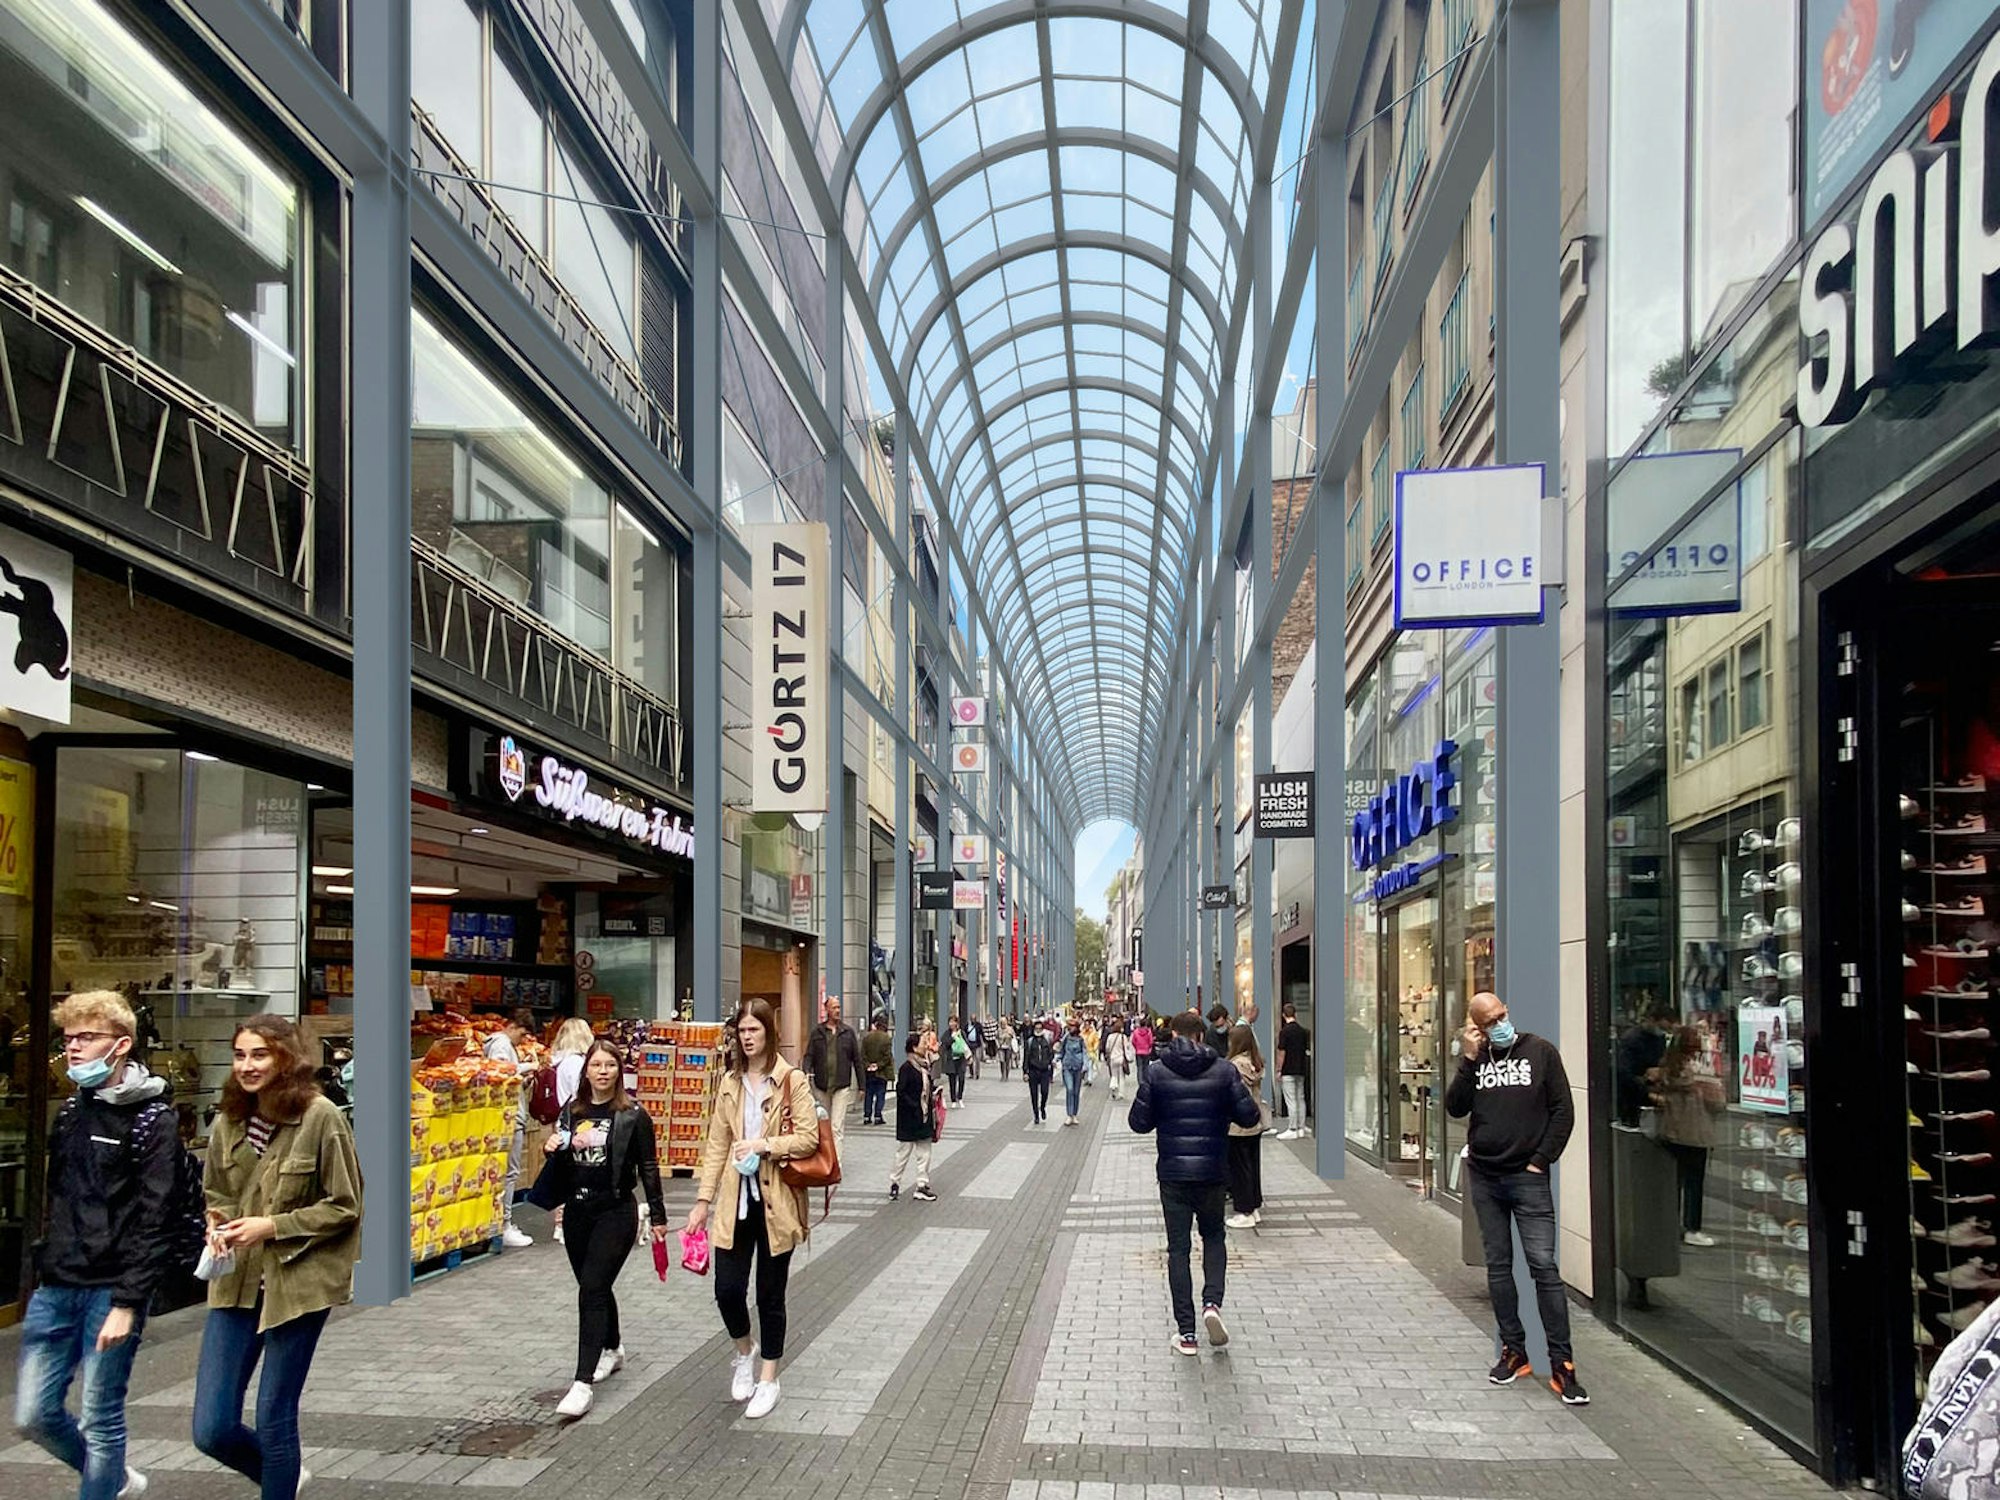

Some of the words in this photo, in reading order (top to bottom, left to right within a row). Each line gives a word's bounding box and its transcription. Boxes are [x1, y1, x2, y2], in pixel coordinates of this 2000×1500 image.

[772, 542, 806, 586] 17
[1413, 557, 1532, 582] OFFICE
[1449, 581, 1494, 591] LONDON
[767, 610, 806, 793] GÖRTZ
[535, 756, 649, 839] Süßwaren
[1260, 781, 1307, 797] LUSH
[1260, 797, 1307, 811] FRESH
[1352, 740, 1459, 871] OFFICE
[1260, 811, 1307, 820] HANDMADE
[1260, 820, 1308, 829] COSMETICS
[1475, 1058, 1532, 1077] JACK&
[1475, 1072, 1532, 1090] JONES
[1938, 1372, 1983, 1425] KANI
